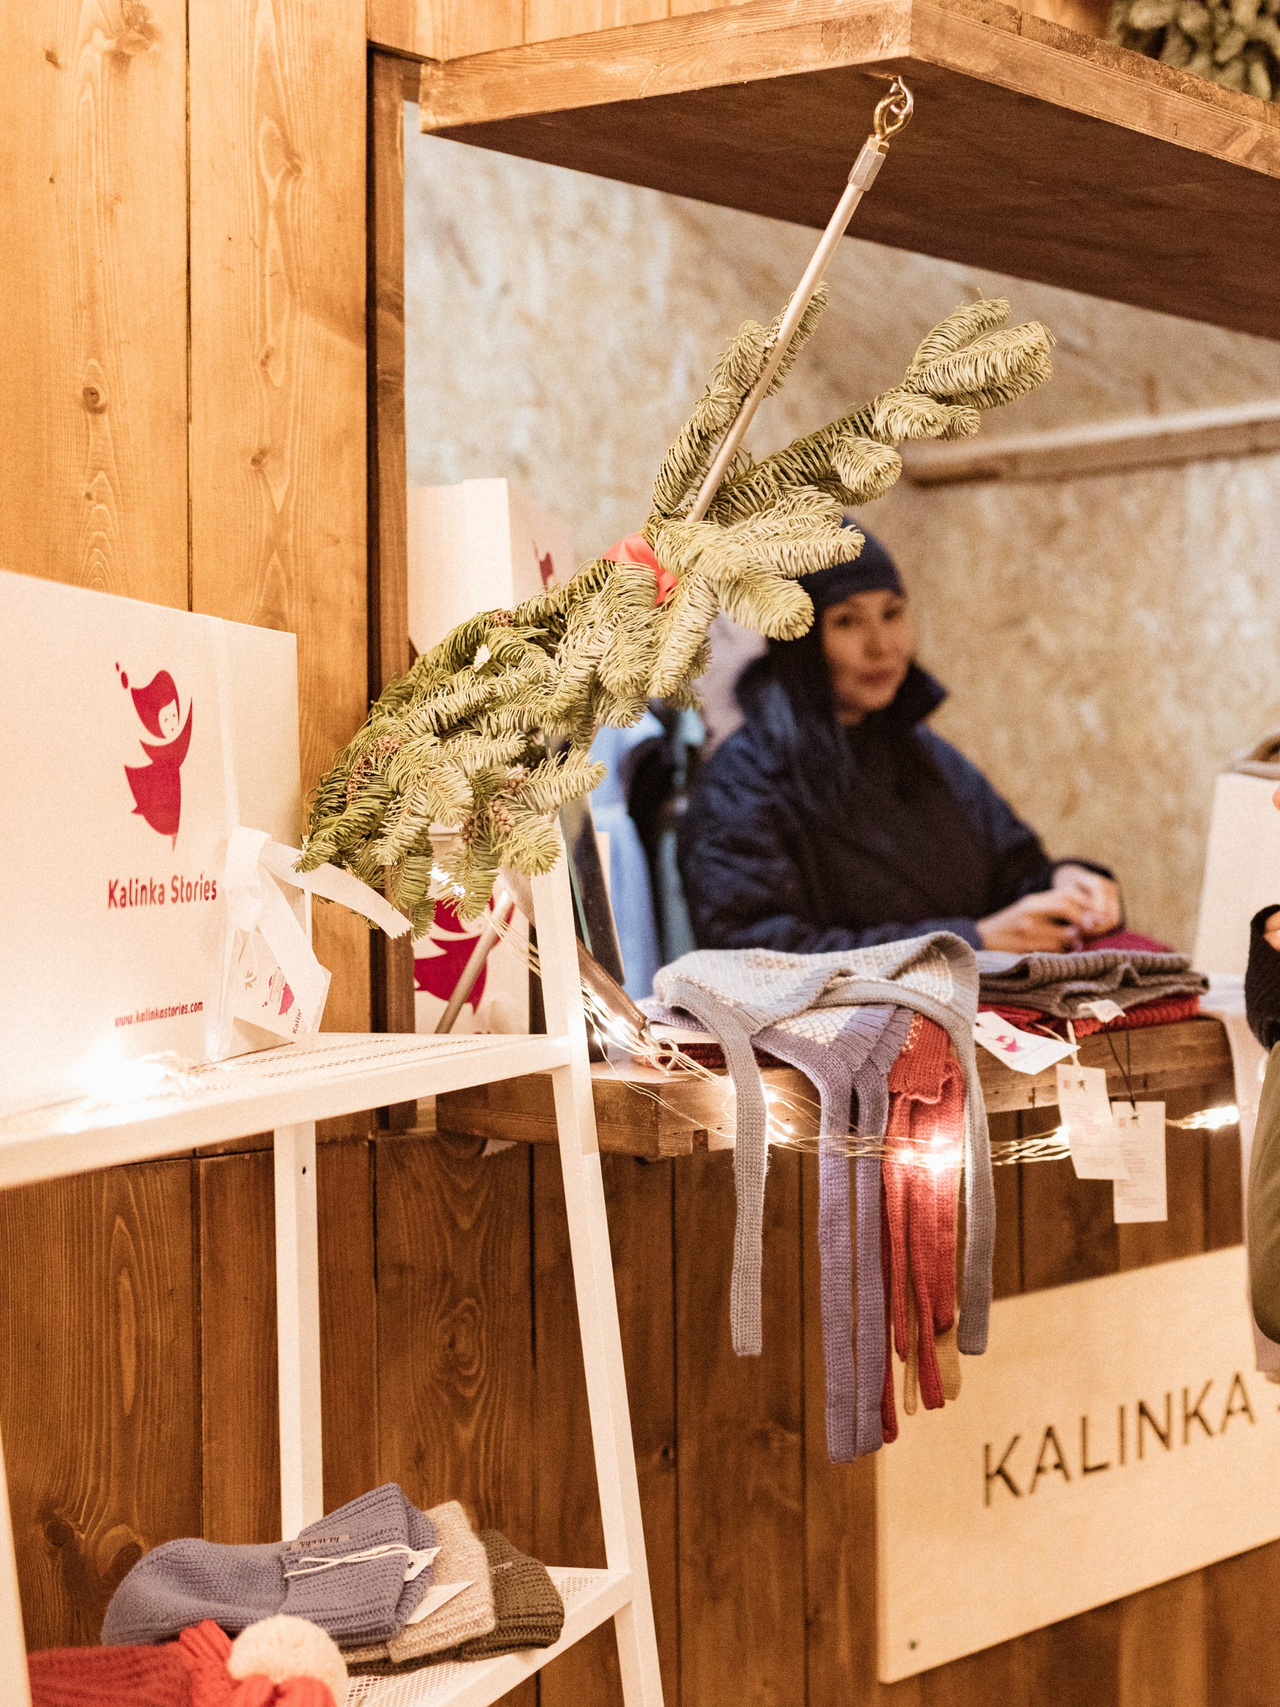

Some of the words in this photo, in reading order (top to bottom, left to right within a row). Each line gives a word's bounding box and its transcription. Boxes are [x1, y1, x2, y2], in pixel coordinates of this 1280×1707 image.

[108, 877, 165, 909] Kalinka
[170, 871, 217, 904] Stories
[983, 1371, 1256, 1508] KALINKA
